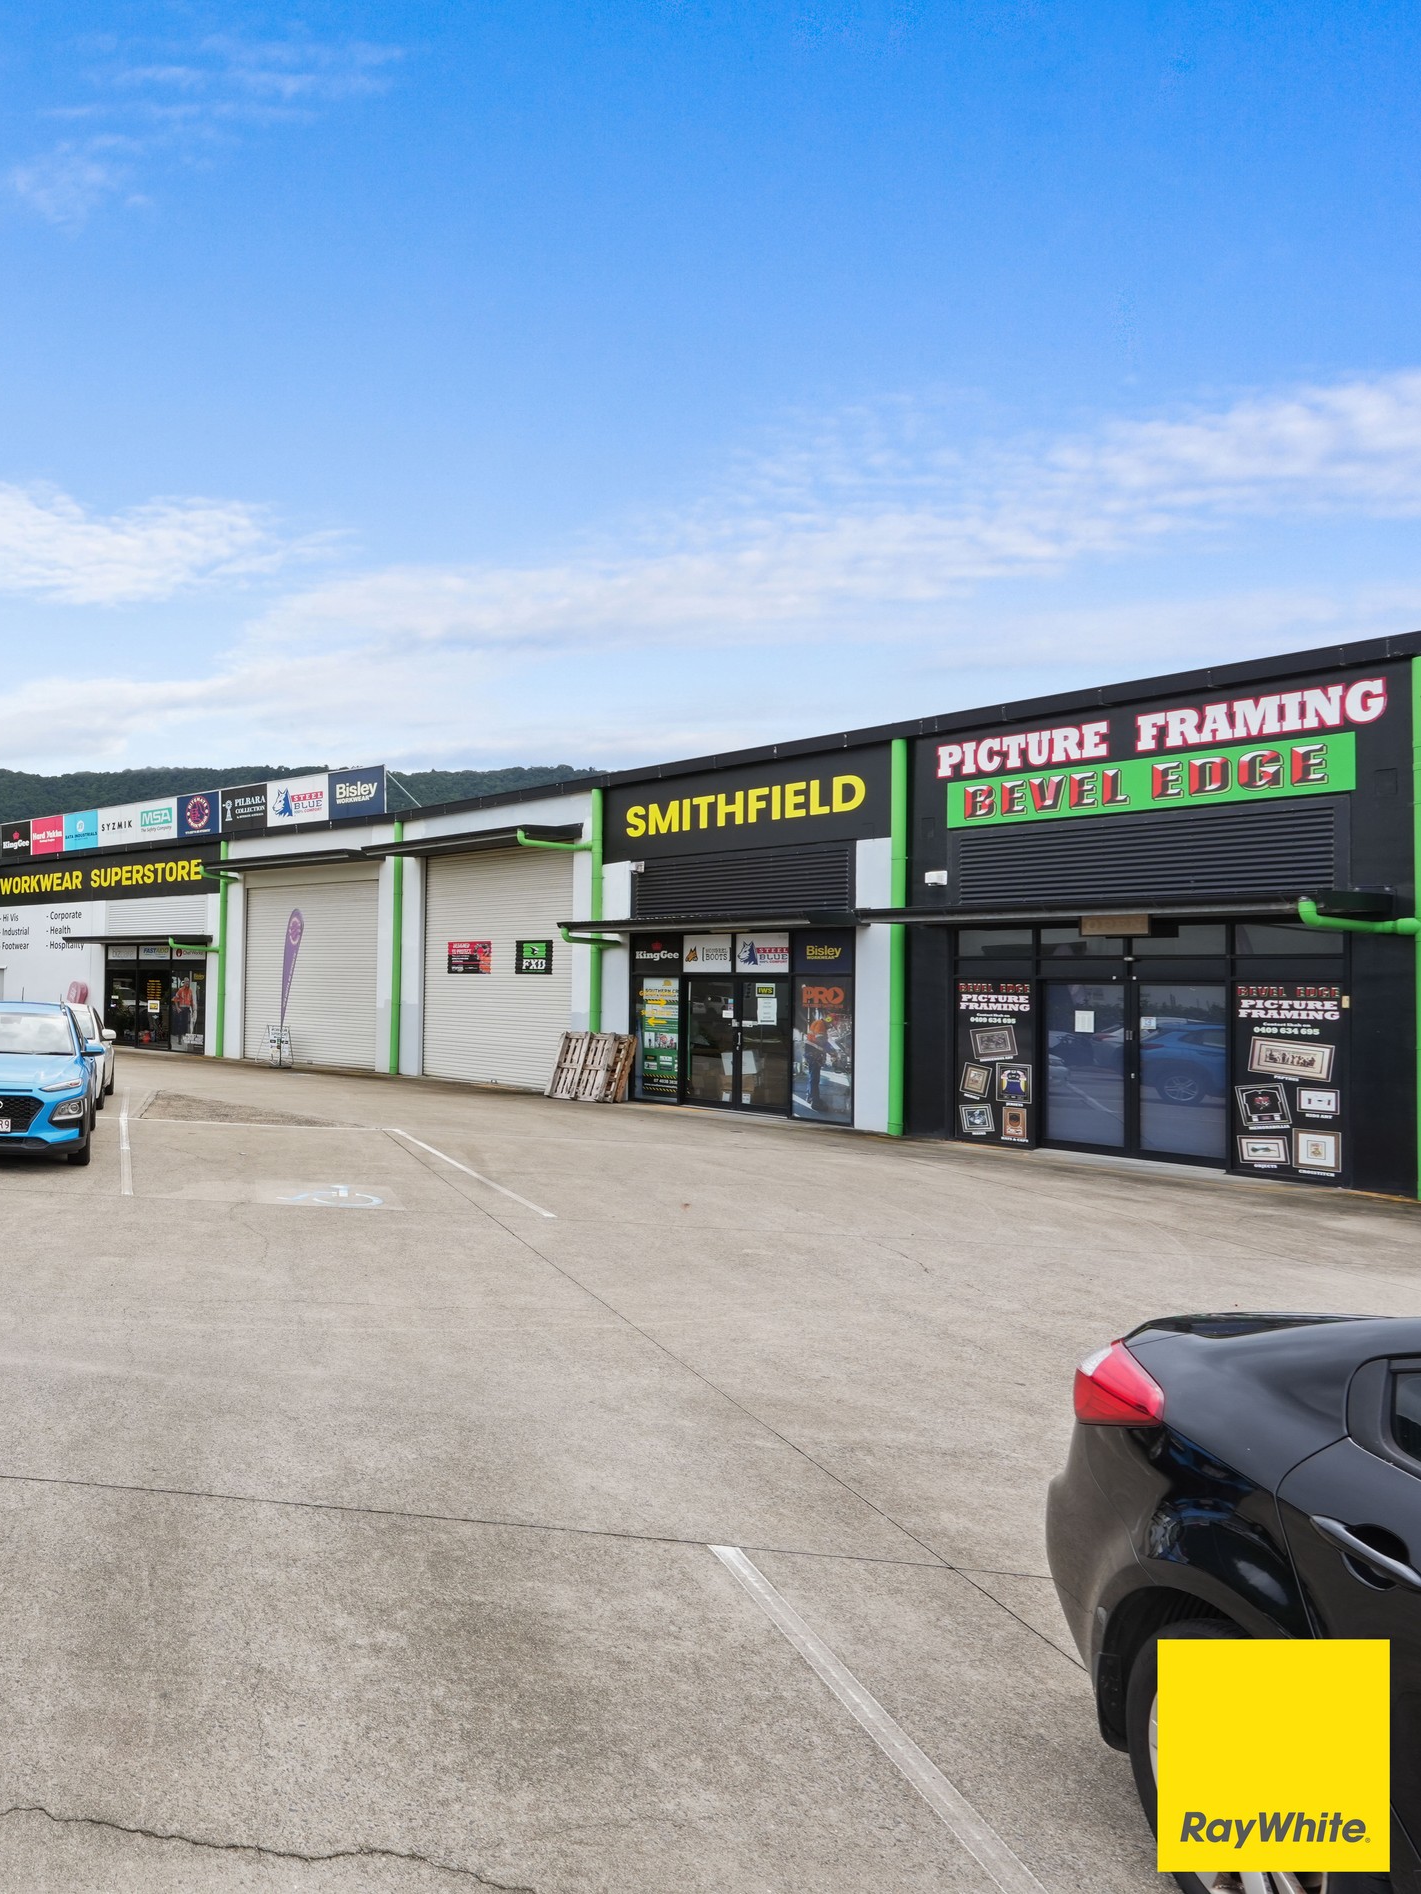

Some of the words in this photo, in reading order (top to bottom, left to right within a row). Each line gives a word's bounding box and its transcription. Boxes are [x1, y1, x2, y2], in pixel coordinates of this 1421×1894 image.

[936, 719, 1110, 779] PICTURE
[1135, 677, 1387, 752] FRAMING
[964, 768, 1131, 821] BEVEL
[1151, 743, 1329, 801] EDGE
[335, 781, 378, 799] Bisley
[234, 795, 266, 807] PILBARA
[293, 791, 323, 801] STEEL
[336, 796, 371, 805] WORKWEAR
[235, 805, 266, 814] COLLECTION
[294, 800, 323, 810] BLUE
[626, 774, 866, 838] SMITHFIELD
[141, 809, 171, 825] MSA
[101, 820, 133, 831] SYZMIK
[32, 831, 46, 841] Hard
[2, 839, 30, 850] KingGee
[0, 871, 83, 895] WORKWEAR
[90, 859, 203, 888] SUPERSTORE
[2, 913, 10, 922] Hi
[10, 913, 19, 922] Vis
[49, 910, 83, 921] Corporate
[2, 926, 29, 936] Industrial
[49, 925, 71, 935] Health
[1, 942, 29, 951] Footwear
[49, 940, 84, 951] Hospitality
[805, 945, 841, 957] Bisley
[635, 950, 680, 961] KingGee
[522, 959, 546, 969] FXD
[958, 983, 994, 993] BEVEL
[1000, 983, 1031, 993] EDGE
[1237, 986, 1287, 998] BEVEL
[1296, 986, 1340, 998] EDGE
[802, 986, 845, 1004] PRO
[961, 994, 1029, 1003] PICTURE
[960, 1002, 1031, 1012] FRAMING
[1240, 1000, 1338, 1010] PICTURE
[1238, 1009, 1340, 1020] FRAMING
[1253, 1026, 1279, 1034] 0409
[1300, 1028, 1320, 1036] 695
